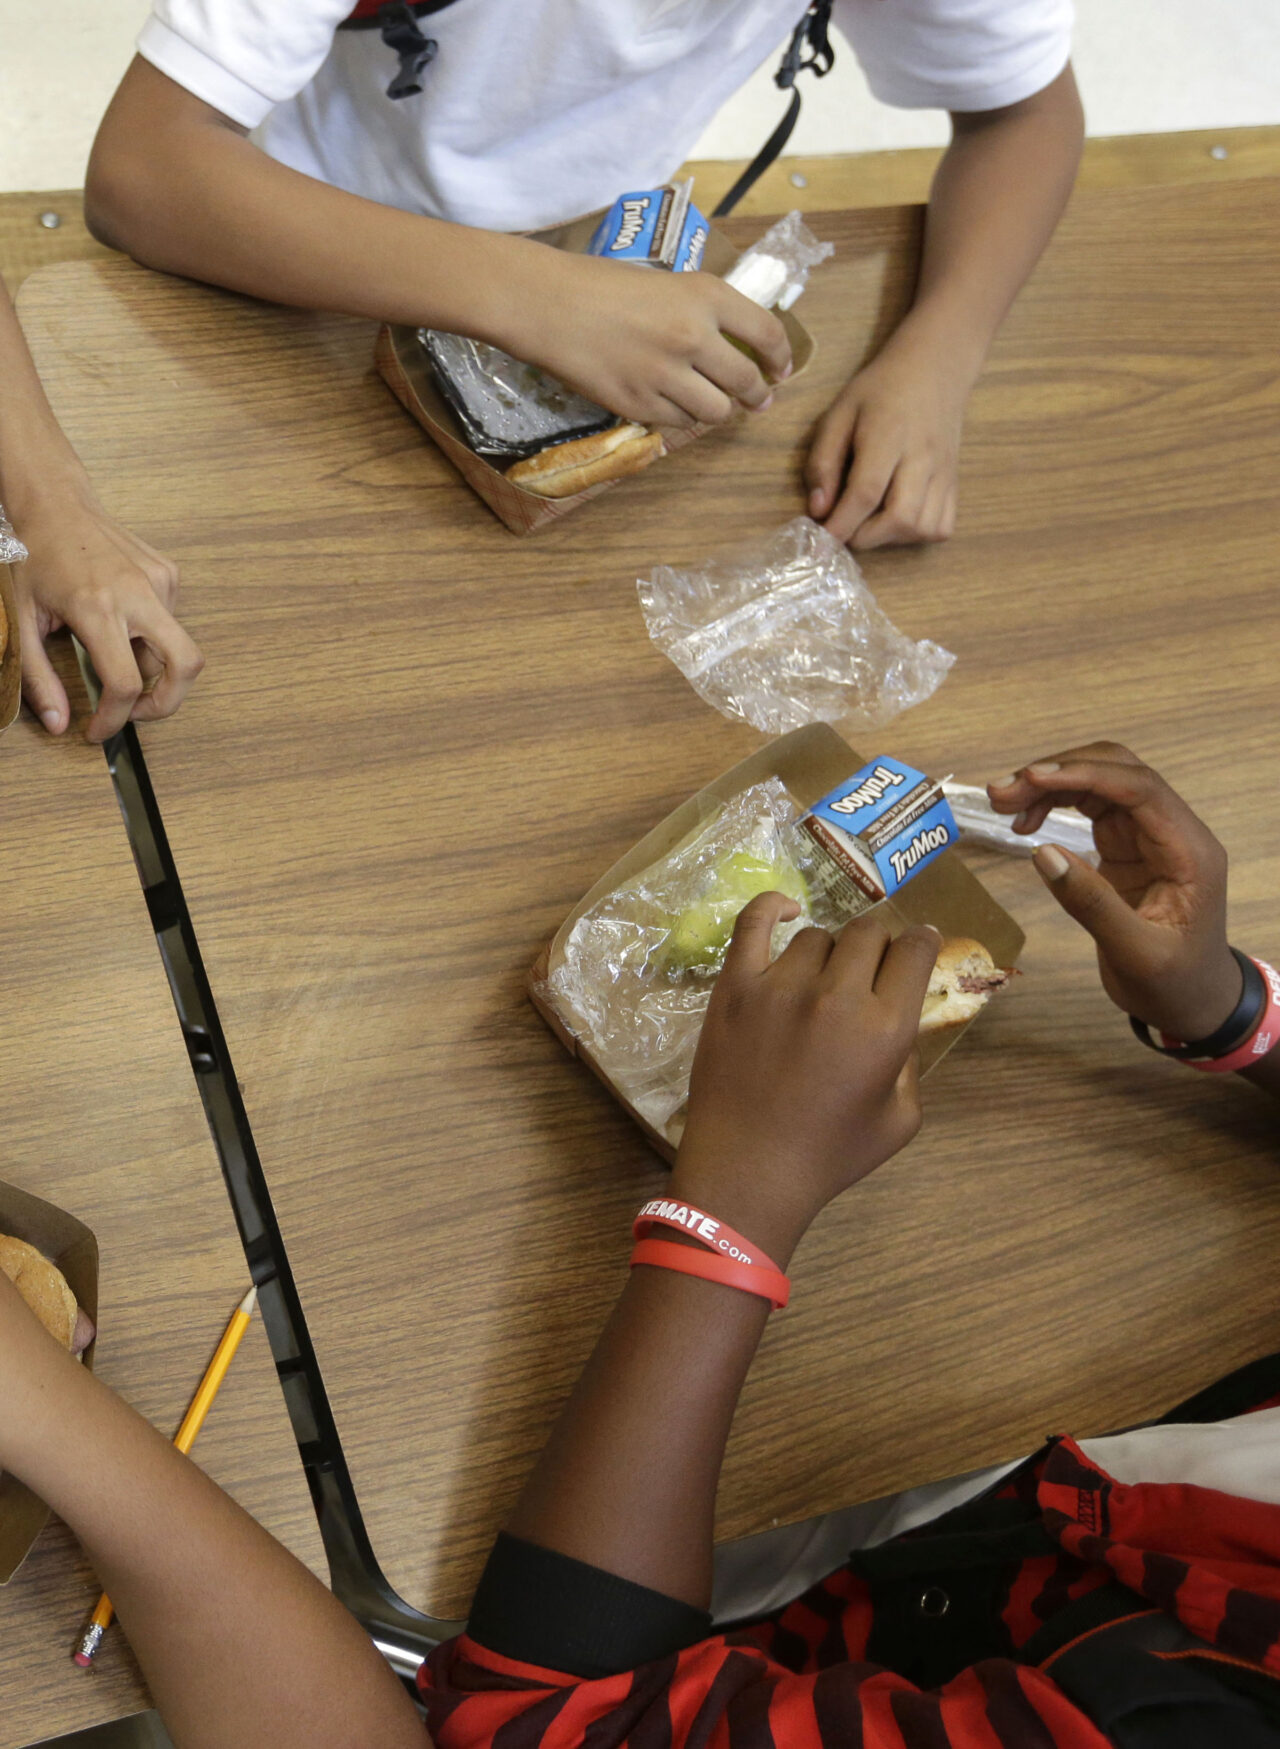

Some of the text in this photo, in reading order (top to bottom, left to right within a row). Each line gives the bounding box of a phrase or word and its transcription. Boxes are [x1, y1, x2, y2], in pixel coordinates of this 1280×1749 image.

[610, 197, 650, 251] TruMoo
[830, 765, 905, 814] TruMoo
[890, 825, 949, 884] TruMoo
[638, 1200, 752, 1265] TEMATE.com
